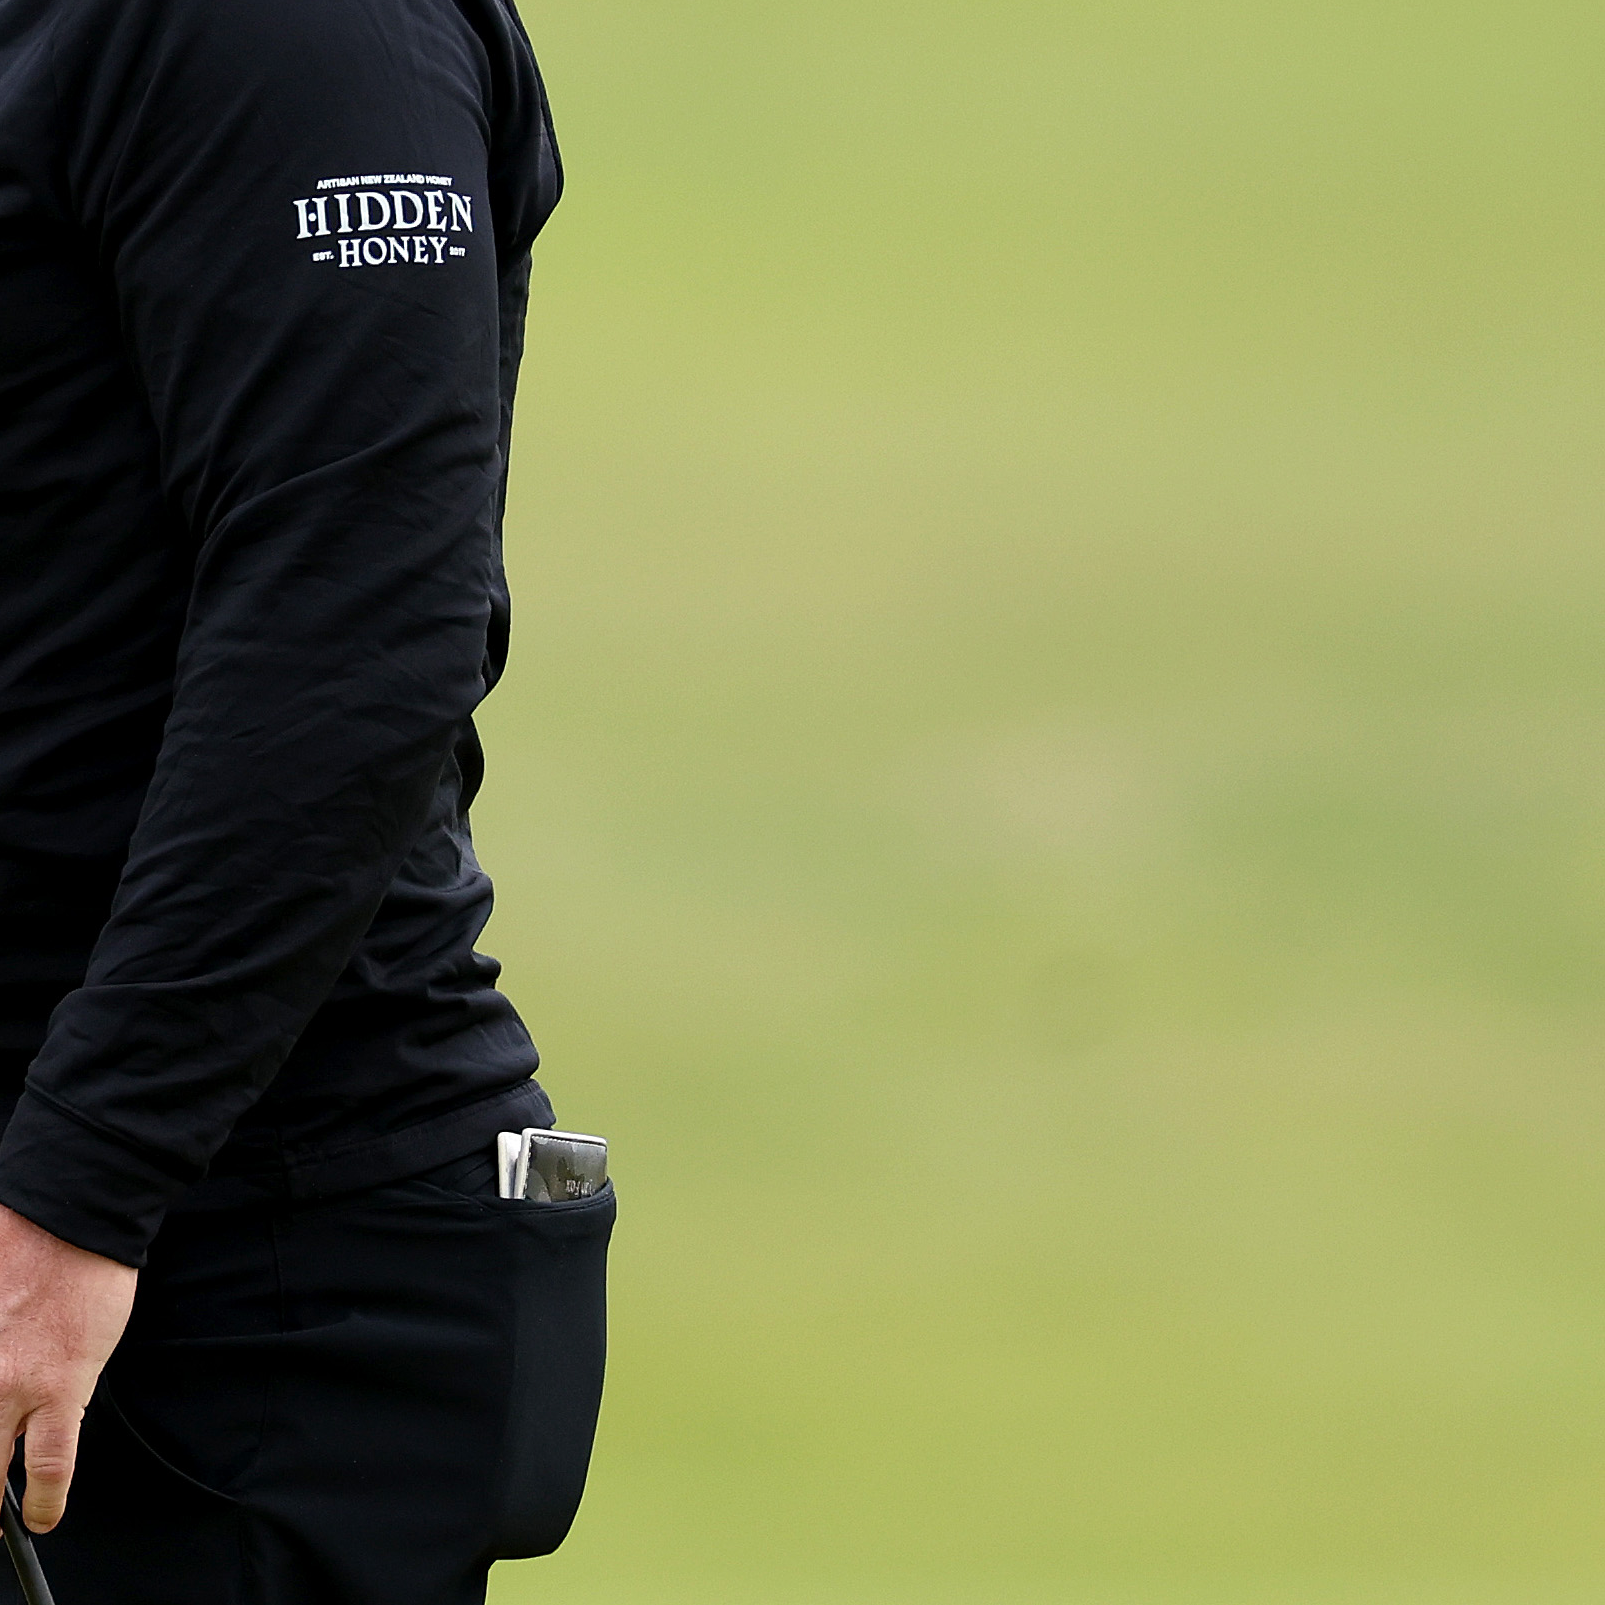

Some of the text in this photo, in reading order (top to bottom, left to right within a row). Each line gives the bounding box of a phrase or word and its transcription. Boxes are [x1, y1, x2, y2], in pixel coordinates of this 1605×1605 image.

[316, 173, 453, 189] ARTISAN NEW ZEALAND HONEY
[292, 190, 475, 239] HIDDEN
[338, 236, 449, 268] HONEY
